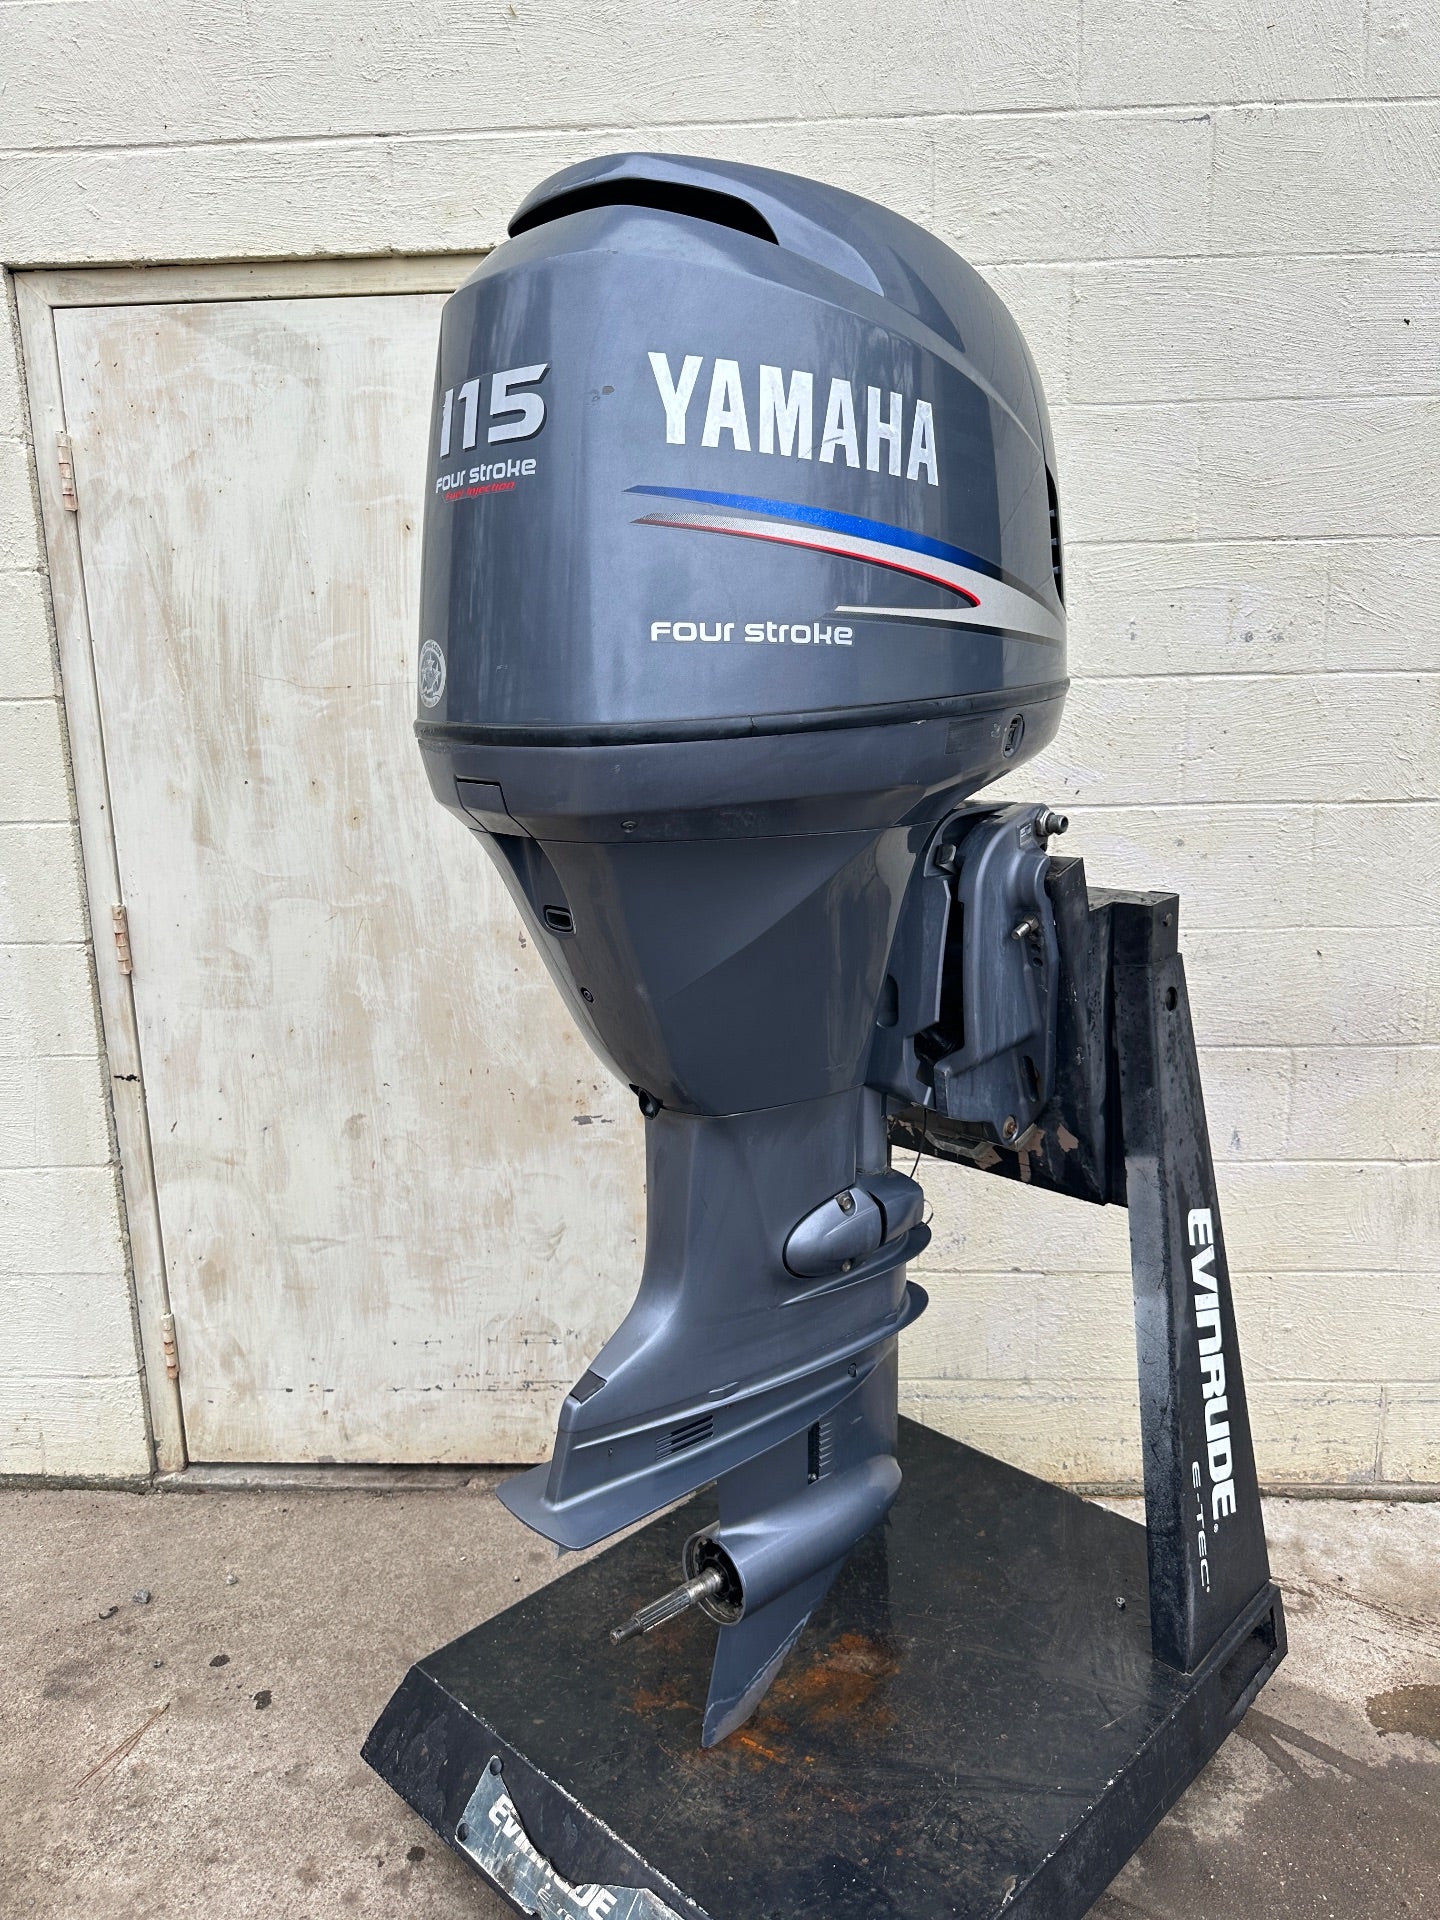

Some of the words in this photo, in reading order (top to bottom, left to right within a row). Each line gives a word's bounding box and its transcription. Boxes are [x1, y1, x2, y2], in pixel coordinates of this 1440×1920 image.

[439, 362, 549, 458] 115
[647, 351, 939, 487] YAMAHA
[744, 621, 853, 646] stroke
[1187, 1208, 1238, 1521] EVINRUDE
[1191, 1461, 1210, 1588] E-TEC
